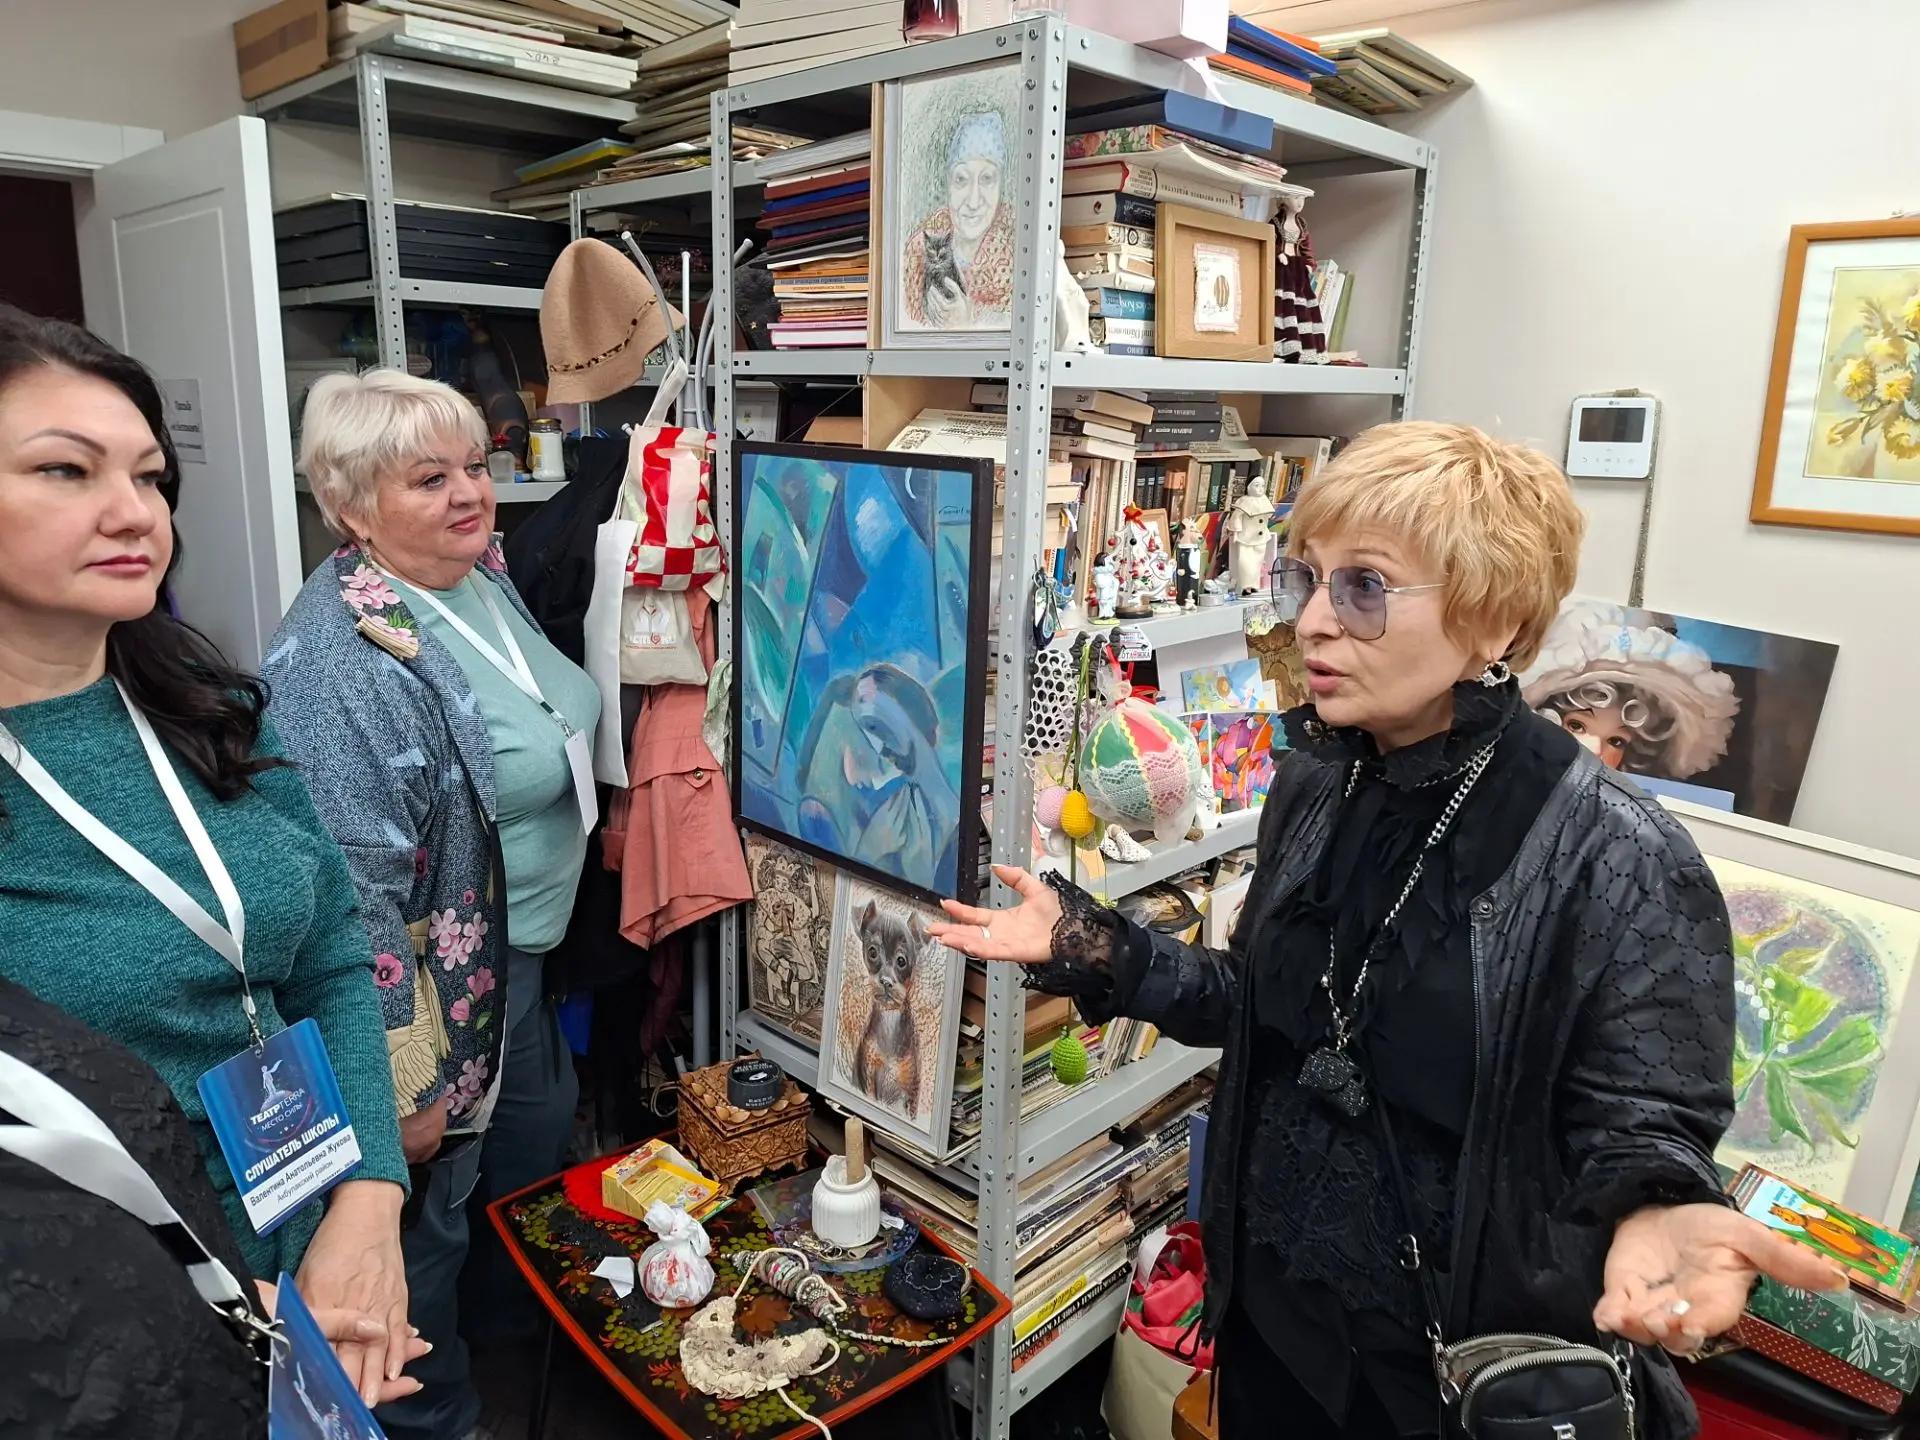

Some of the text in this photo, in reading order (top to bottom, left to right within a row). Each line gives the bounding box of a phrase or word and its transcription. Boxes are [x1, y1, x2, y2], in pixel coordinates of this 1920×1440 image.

[245, 1113, 340, 1182] СЛУШАТЕЛЬ ШКОЛЫ
[261, 1113, 284, 1131] МЕСТО
[250, 1134, 352, 1206] Валентина Анатольевна Жукова
